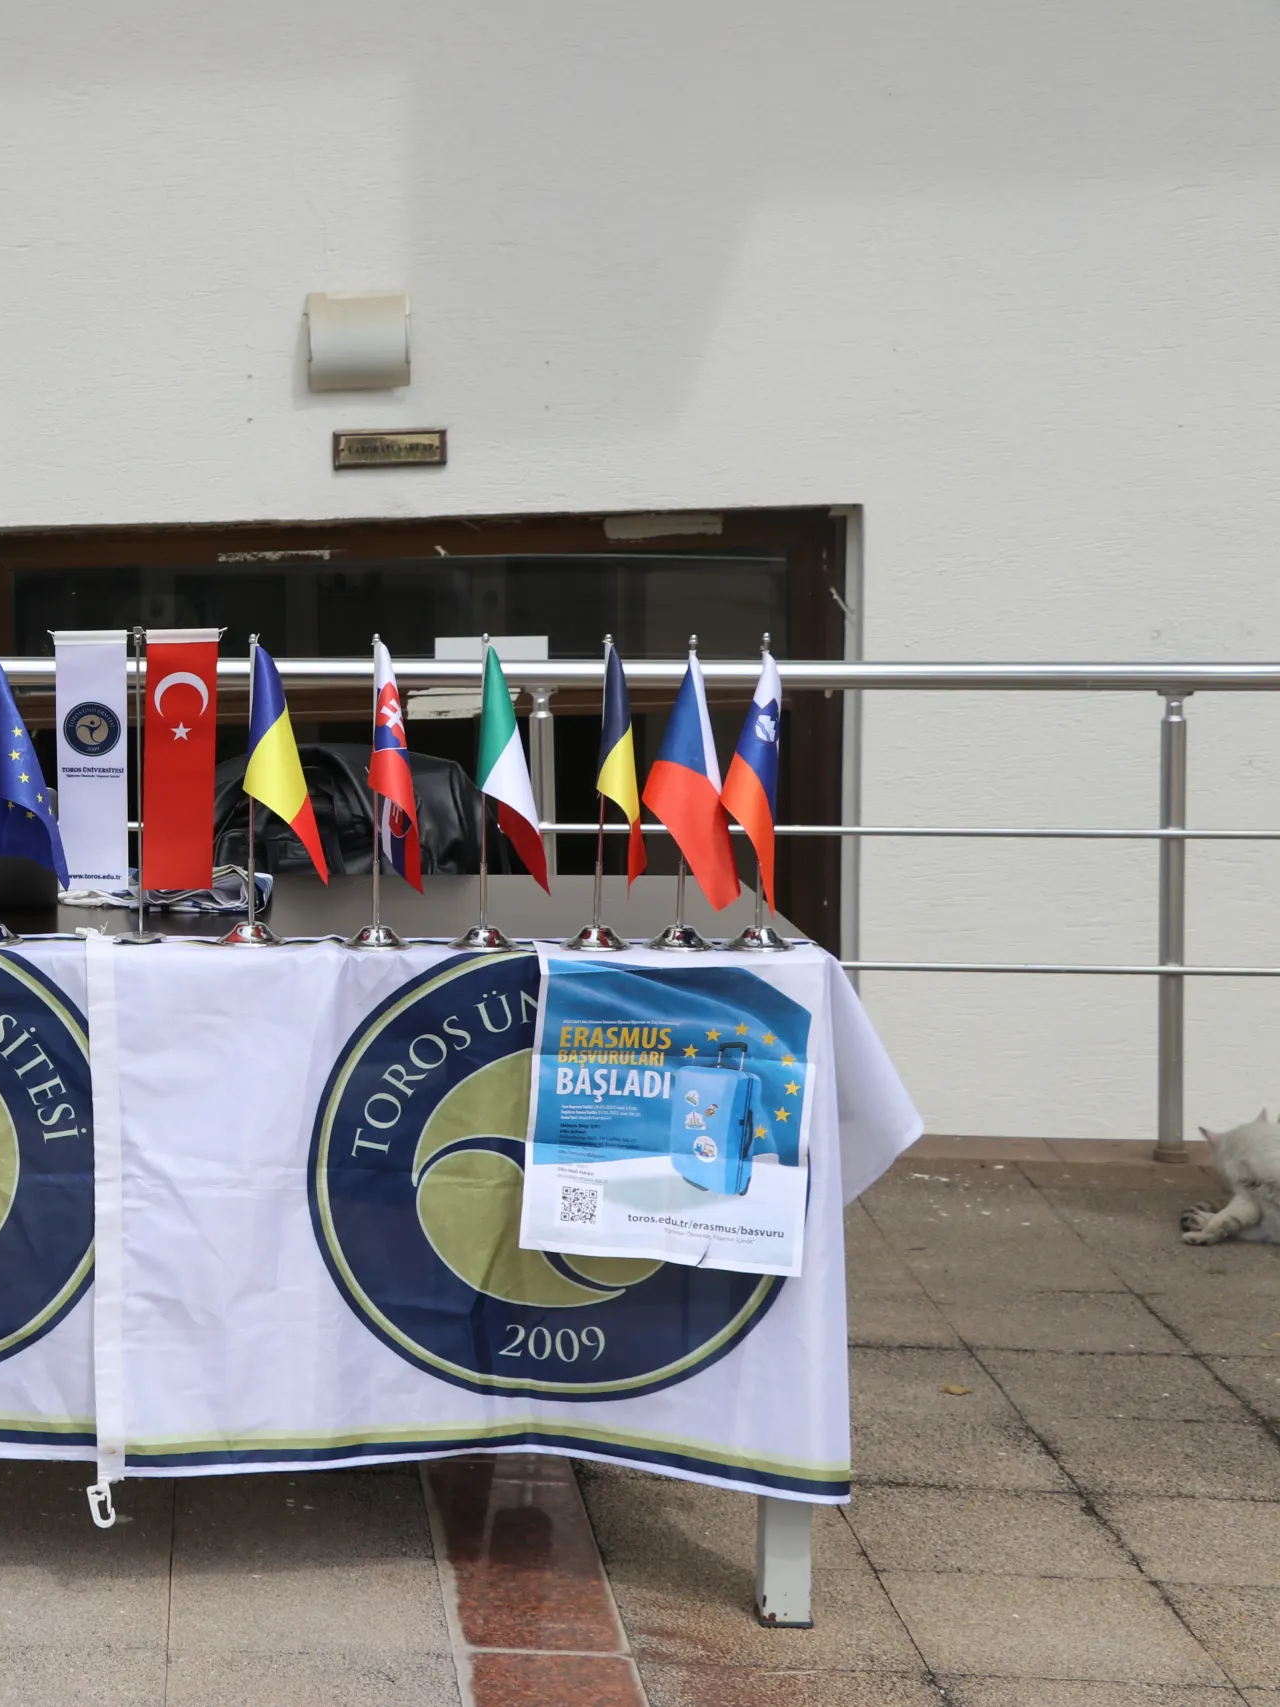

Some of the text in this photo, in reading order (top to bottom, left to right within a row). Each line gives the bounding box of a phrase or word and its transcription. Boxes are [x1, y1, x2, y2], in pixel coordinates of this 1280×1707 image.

[559, 1026, 672, 1050] ERASMUS
[558, 1049, 665, 1068] BAŞVURULARI
[351, 1014, 472, 1159] TOROS
[556, 1067, 671, 1103] BAŞLADI
[628, 1213, 784, 1238] toros.edu.tr/erasmus/basvuru
[498, 1323, 606, 1363] 2009
